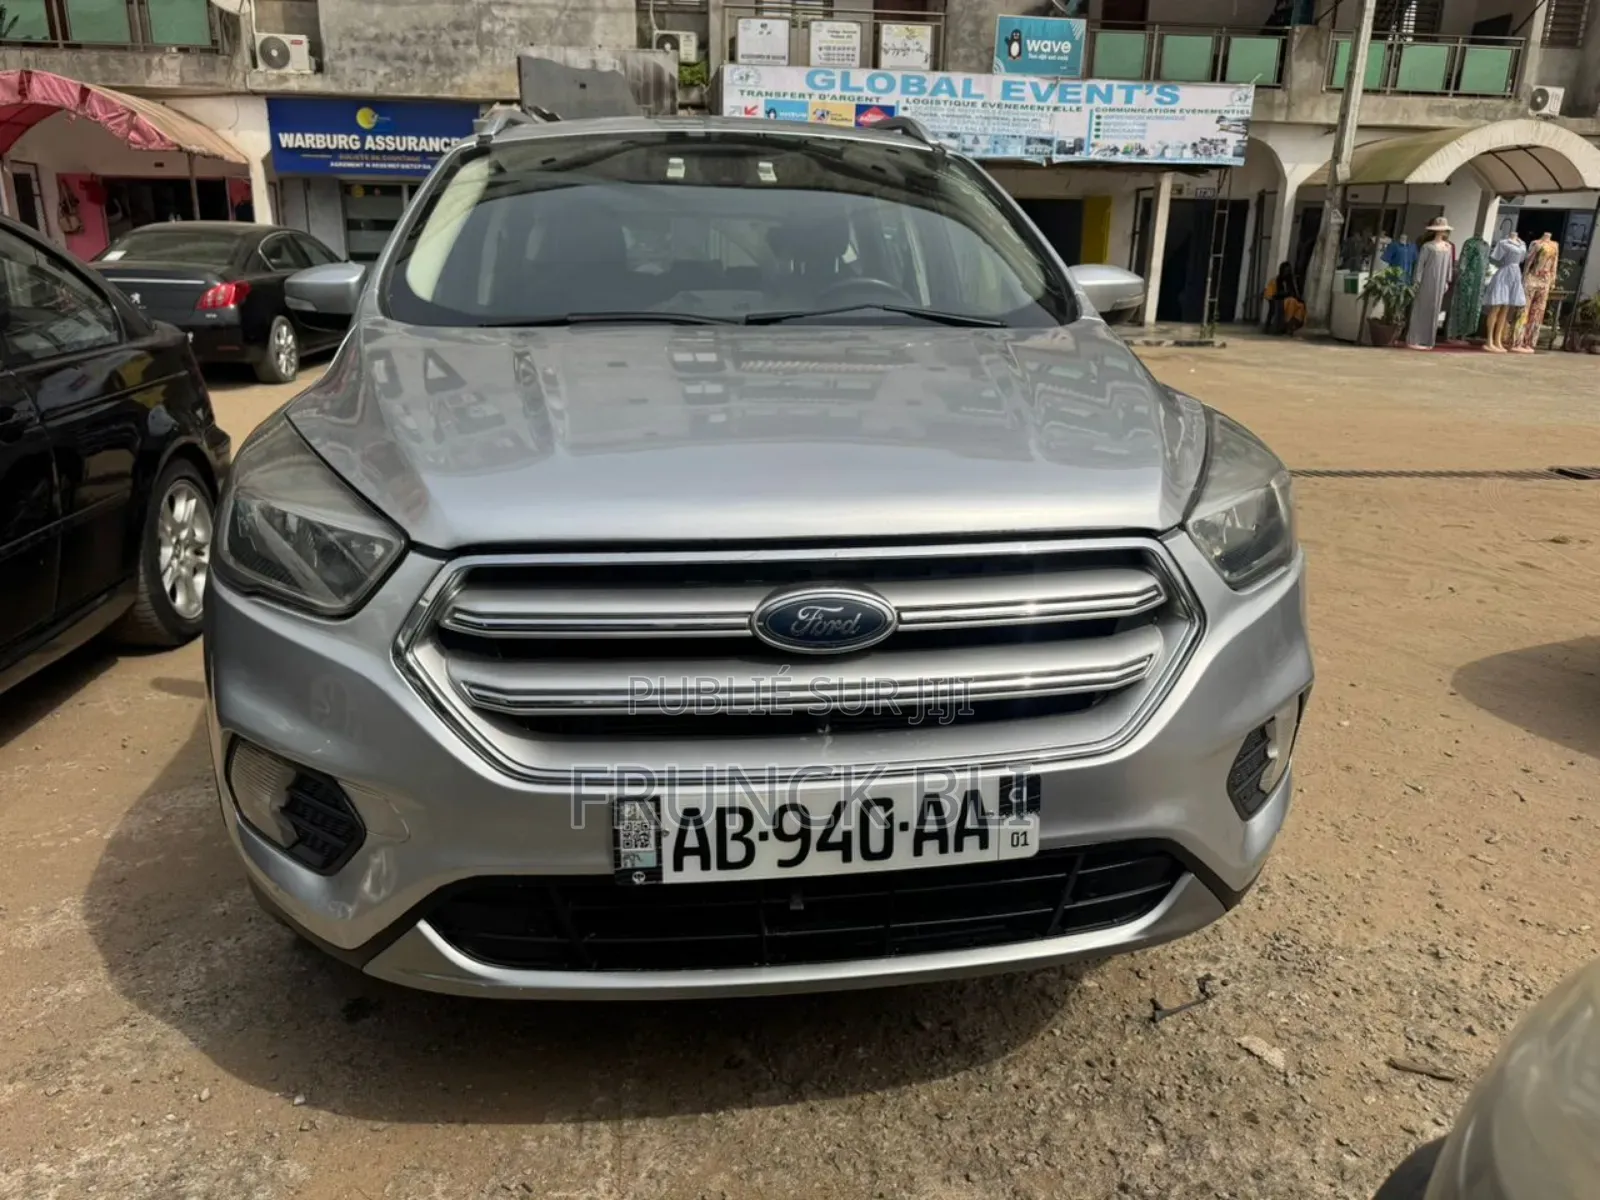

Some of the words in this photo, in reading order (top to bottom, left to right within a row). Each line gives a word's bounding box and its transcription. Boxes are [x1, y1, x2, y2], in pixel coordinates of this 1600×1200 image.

[1026, 39, 1072, 54] wave
[739, 89, 813, 100] TRANSFERT
[818, 93, 882, 103] D'ARGENT
[805, 69, 986, 99] GLOBAL
[1002, 80, 1182, 106] EVENT'S
[905, 99, 979, 108] LOGISTIQUE
[278, 132, 361, 150] WARBURG
[790, 605, 862, 637] Ford
[1010, 831, 1030, 848] 01
